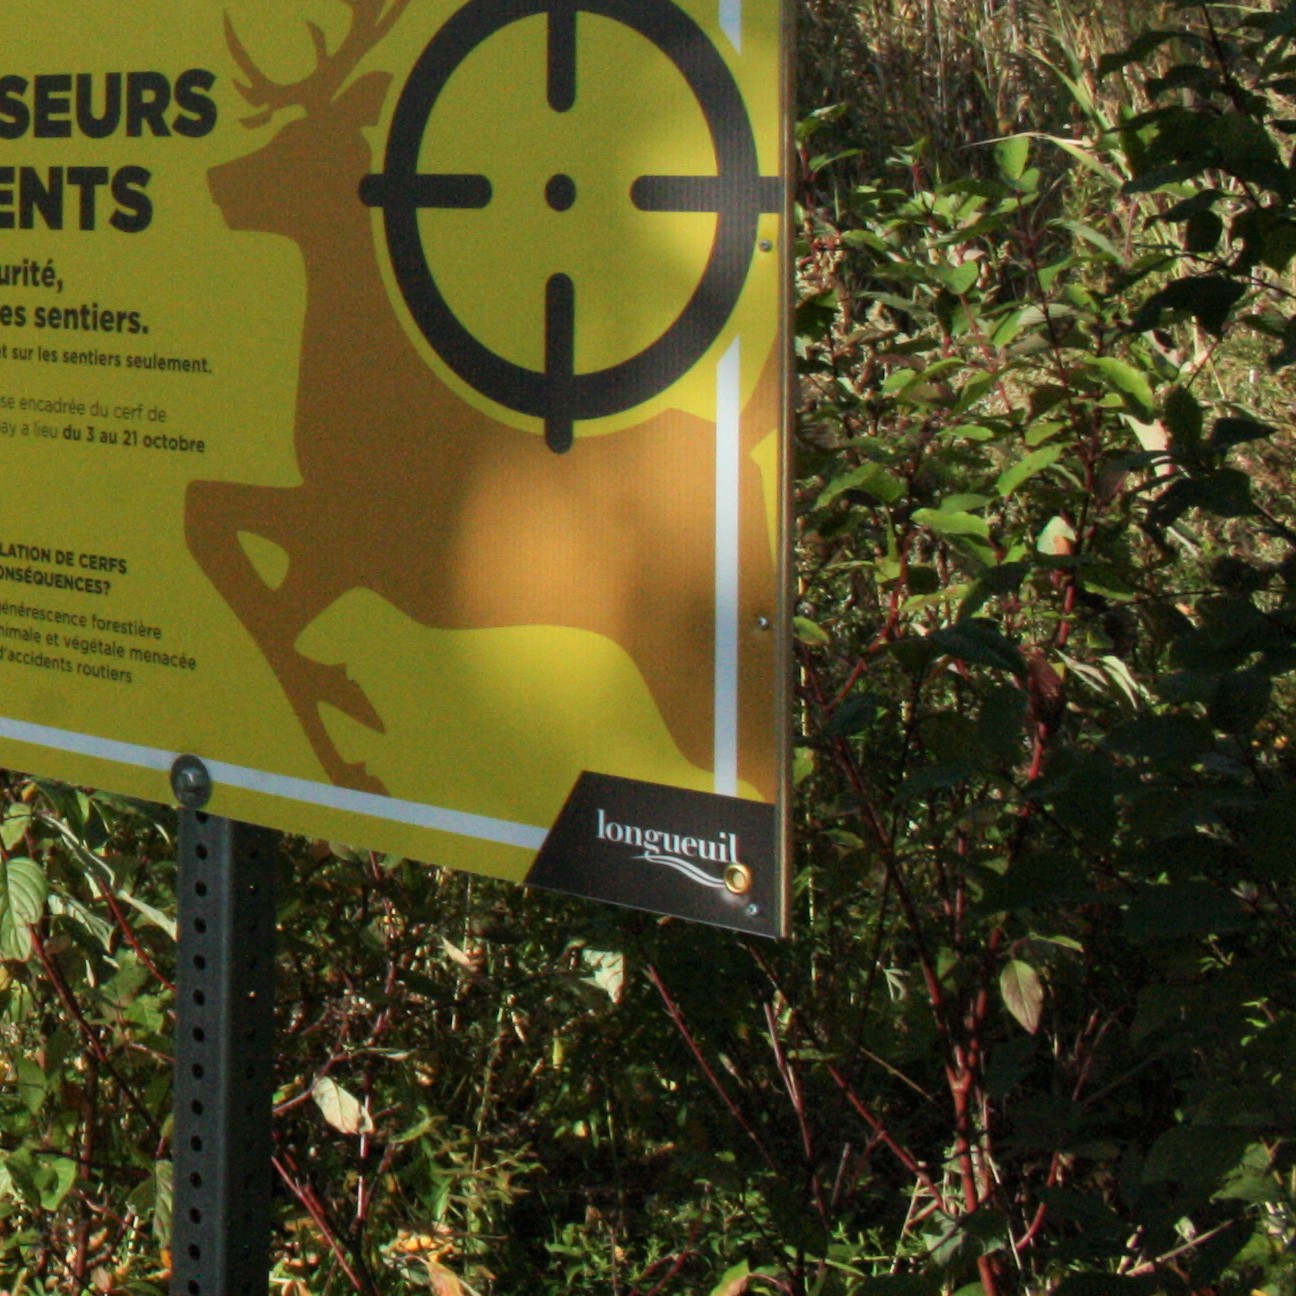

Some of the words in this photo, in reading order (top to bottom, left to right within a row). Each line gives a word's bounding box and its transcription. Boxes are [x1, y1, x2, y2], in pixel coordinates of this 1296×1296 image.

[34, 302, 149, 334] sentiers.
[11, 348, 33, 361] sur
[37, 346, 58, 363] les
[62, 350, 121, 367] sentiers
[125, 354, 213, 374] seulement.
[18, 397, 85, 416] encadrée
[89, 400, 108, 418] du
[112, 404, 143, 421] cerf
[146, 405, 167, 424] de
[20, 423, 29, 436] a
[33, 421, 58, 439] lieu
[61, 424, 81, 441] du
[85, 426, 95, 443] 3
[99, 431, 118, 445] au
[122, 429, 137, 447] 21
[142, 433, 205, 454] octobre
[90, 614, 161, 640] forestière
[45, 631, 59, 647] et
[63, 634, 125, 659] végétale
[129, 649, 196, 671] menacée
[76, 663, 132, 684] routiers
[595, 807, 738, 864] longueuil
